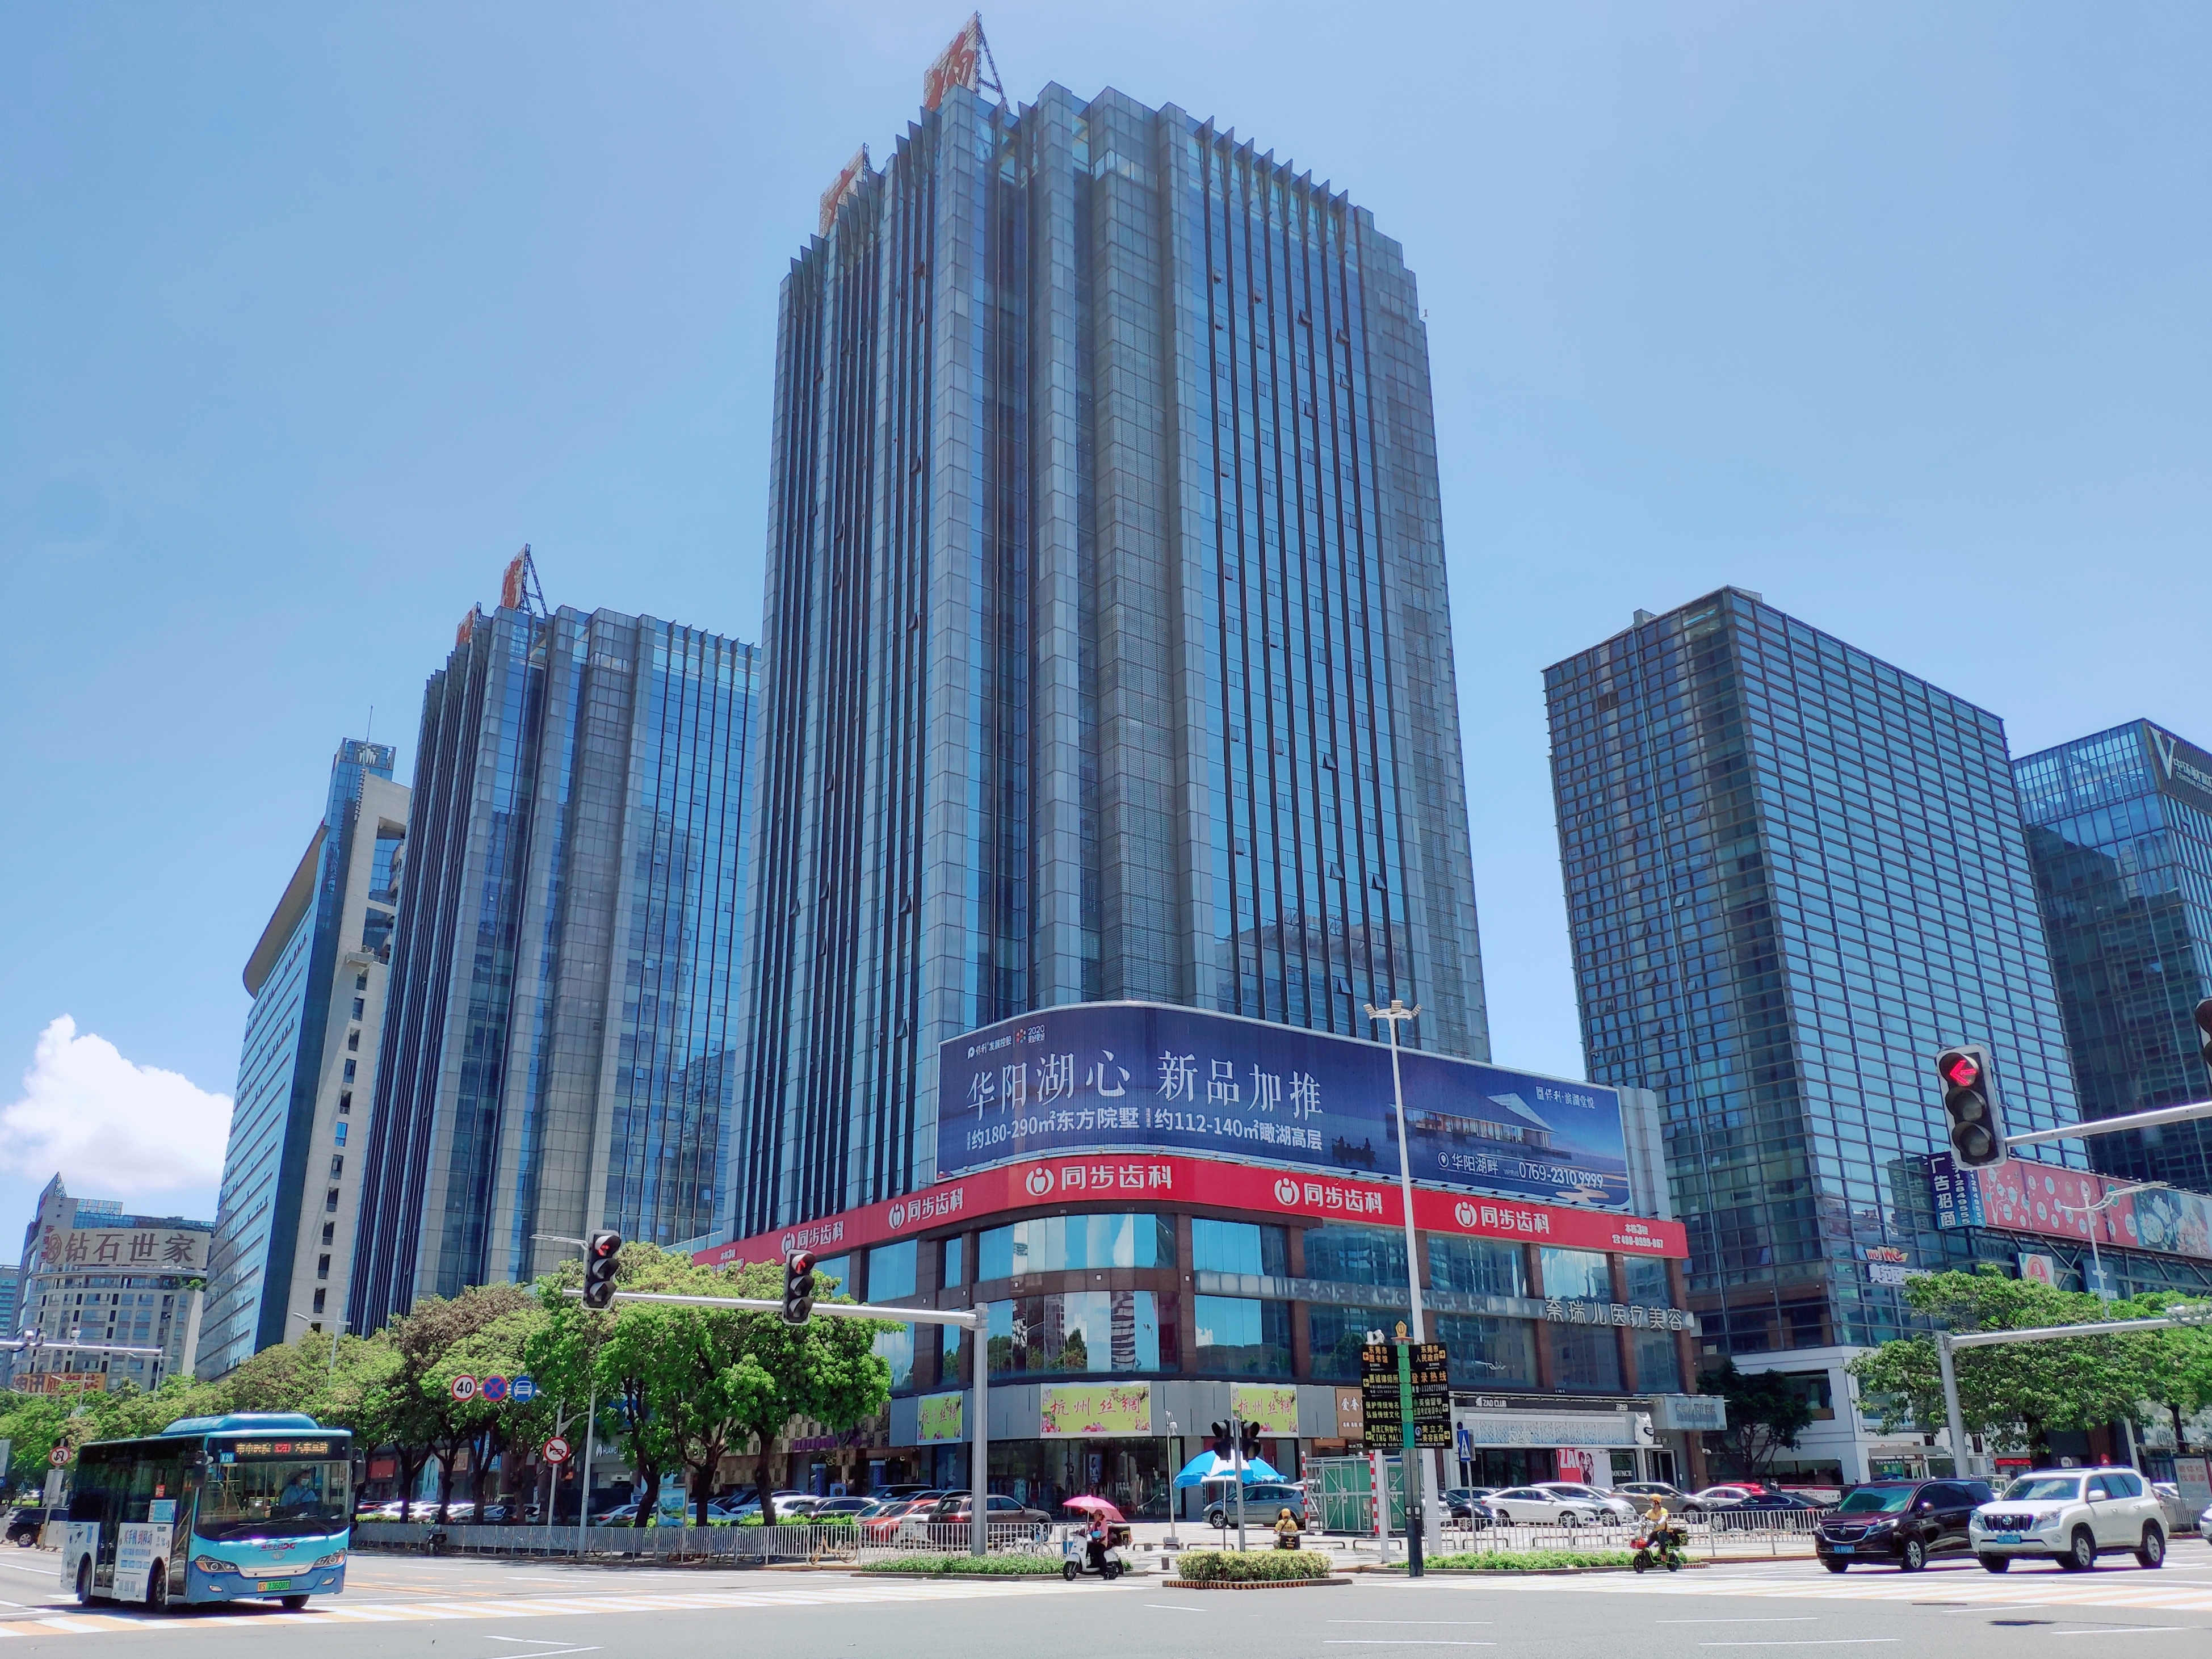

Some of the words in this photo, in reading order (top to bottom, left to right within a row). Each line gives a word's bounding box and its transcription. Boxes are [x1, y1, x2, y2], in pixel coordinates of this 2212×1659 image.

[1028, 1024, 1045, 1036] 2020
[967, 1049, 1130, 1122] 华阳湖心
[1156, 1049, 1324, 1121] 新品加推
[1451, 1153, 1499, 1175] 华阳湖畔
[1061, 1165, 1173, 1190] 同步齿科
[1303, 1182, 1383, 1215] 同步齿科
[1930, 1157, 1956, 1227] 广告招商
[908, 1187, 964, 1223] 同步齿科
[1480, 1206, 1550, 1234] 同步齿科
[797, 1220, 844, 1249] 同步齿科
[65, 1232, 196, 1264] 钻石世家
[1545, 1297, 1683, 1331] 奈瑞儿医疗美容
[1416, 1354, 1439, 1363] 人民政府
[1421, 1345, 1439, 1354] 东莞市
[456, 1381, 472, 1393] 40
[1050, 1397, 1141, 1417] 杭州丝绸
[1238, 1398, 1292, 1417] 杭州丝绸
[1422, 1425, 1443, 1433] 美立方
[1422, 1433, 1445, 1442] 美容医院
[221, 1453, 233, 1462] X20
